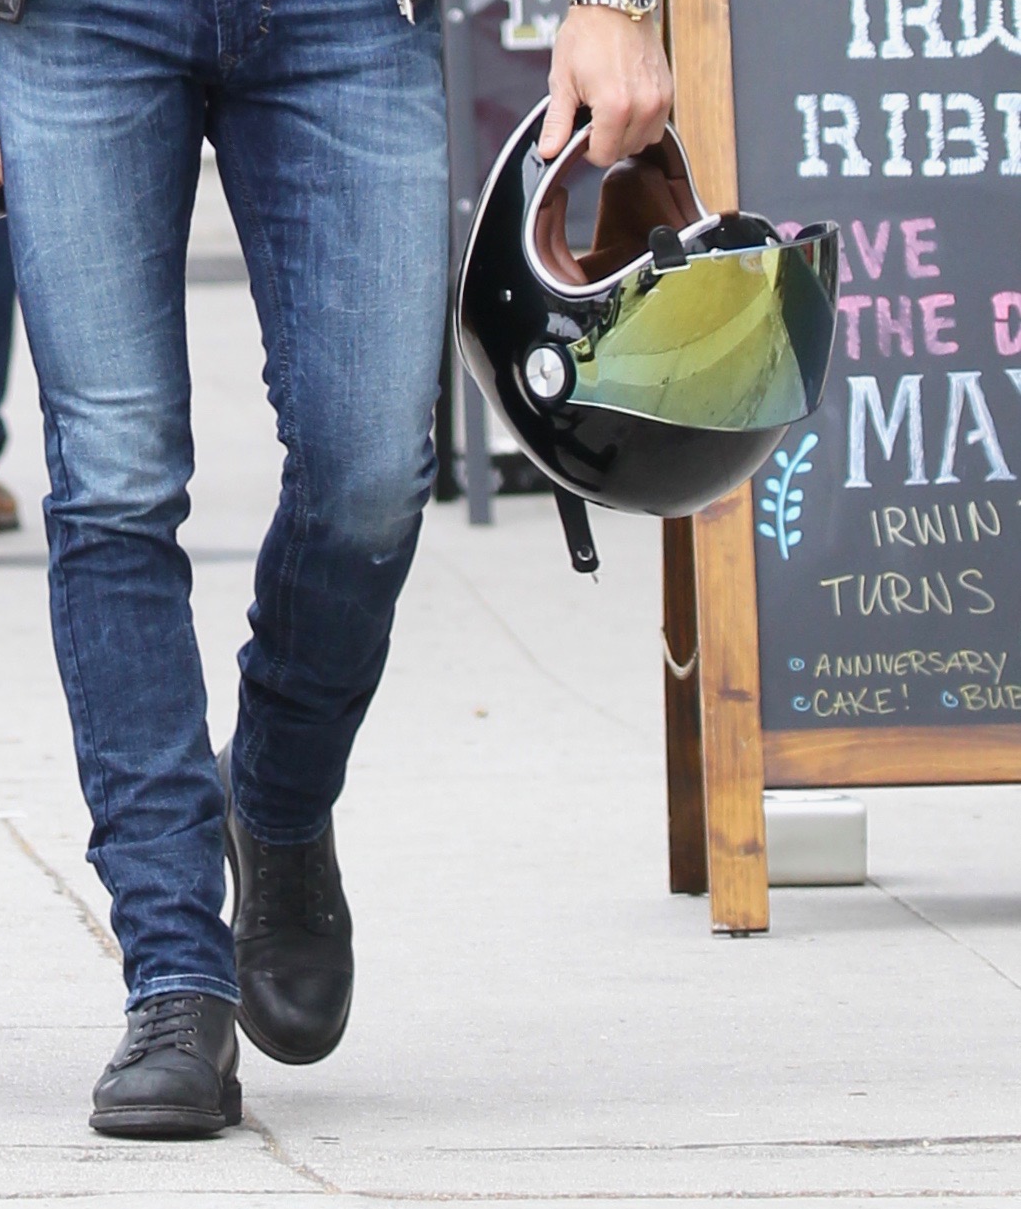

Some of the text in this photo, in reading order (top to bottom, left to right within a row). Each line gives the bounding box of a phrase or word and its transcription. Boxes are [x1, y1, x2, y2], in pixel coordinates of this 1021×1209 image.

[837, 293, 959, 360] THE
[844, 368, 1021, 488] MA
[869, 500, 1001, 548] IRWIN
[819, 569, 995, 617] TURNS
[813, 650, 1007, 684] ANNIVERSARY
[812, 683, 910, 717] CAKE!
